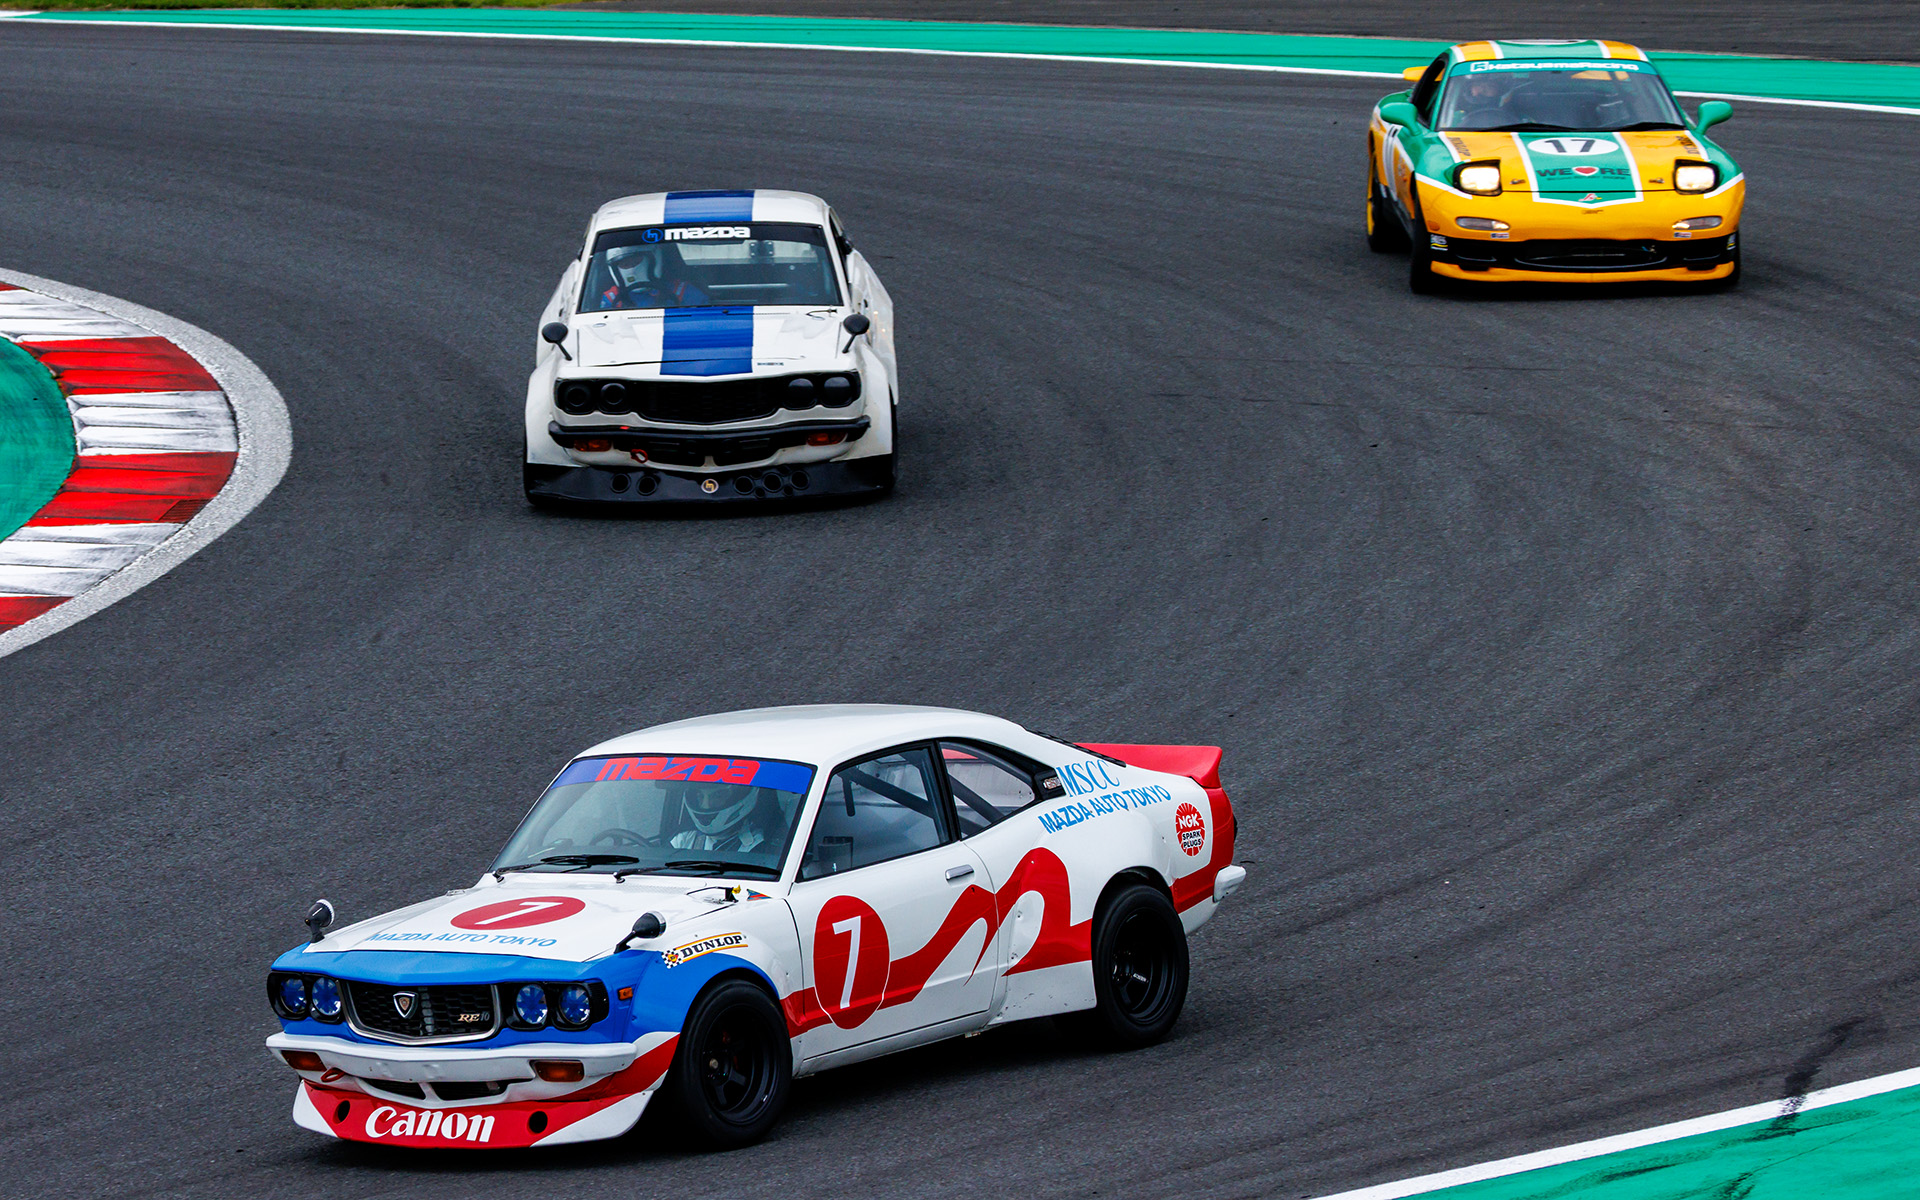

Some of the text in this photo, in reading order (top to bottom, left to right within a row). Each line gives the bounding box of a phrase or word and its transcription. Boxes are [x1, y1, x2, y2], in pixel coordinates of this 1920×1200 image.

[1544, 139, 1596, 153] 17
[1537, 168, 1631, 177] WE RE
[664, 226, 751, 241] mazda
[595, 757, 761, 785] mazda
[1056, 760, 1120, 797] MSCC
[1038, 784, 1171, 834] MAZDA AUTO TOKYO
[1179, 814, 1199, 830] NGK
[1181, 831, 1201, 841] SPARK
[1183, 839, 1202, 849] PLUGS
[475, 901, 563, 925] 7
[367, 932, 557, 947] MAZDA AUTO TOKYO
[680, 935, 743, 958] DUNLOP
[832, 916, 862, 1009] 7
[458, 1013, 480, 1023] RE
[365, 1106, 495, 1143] Canon
